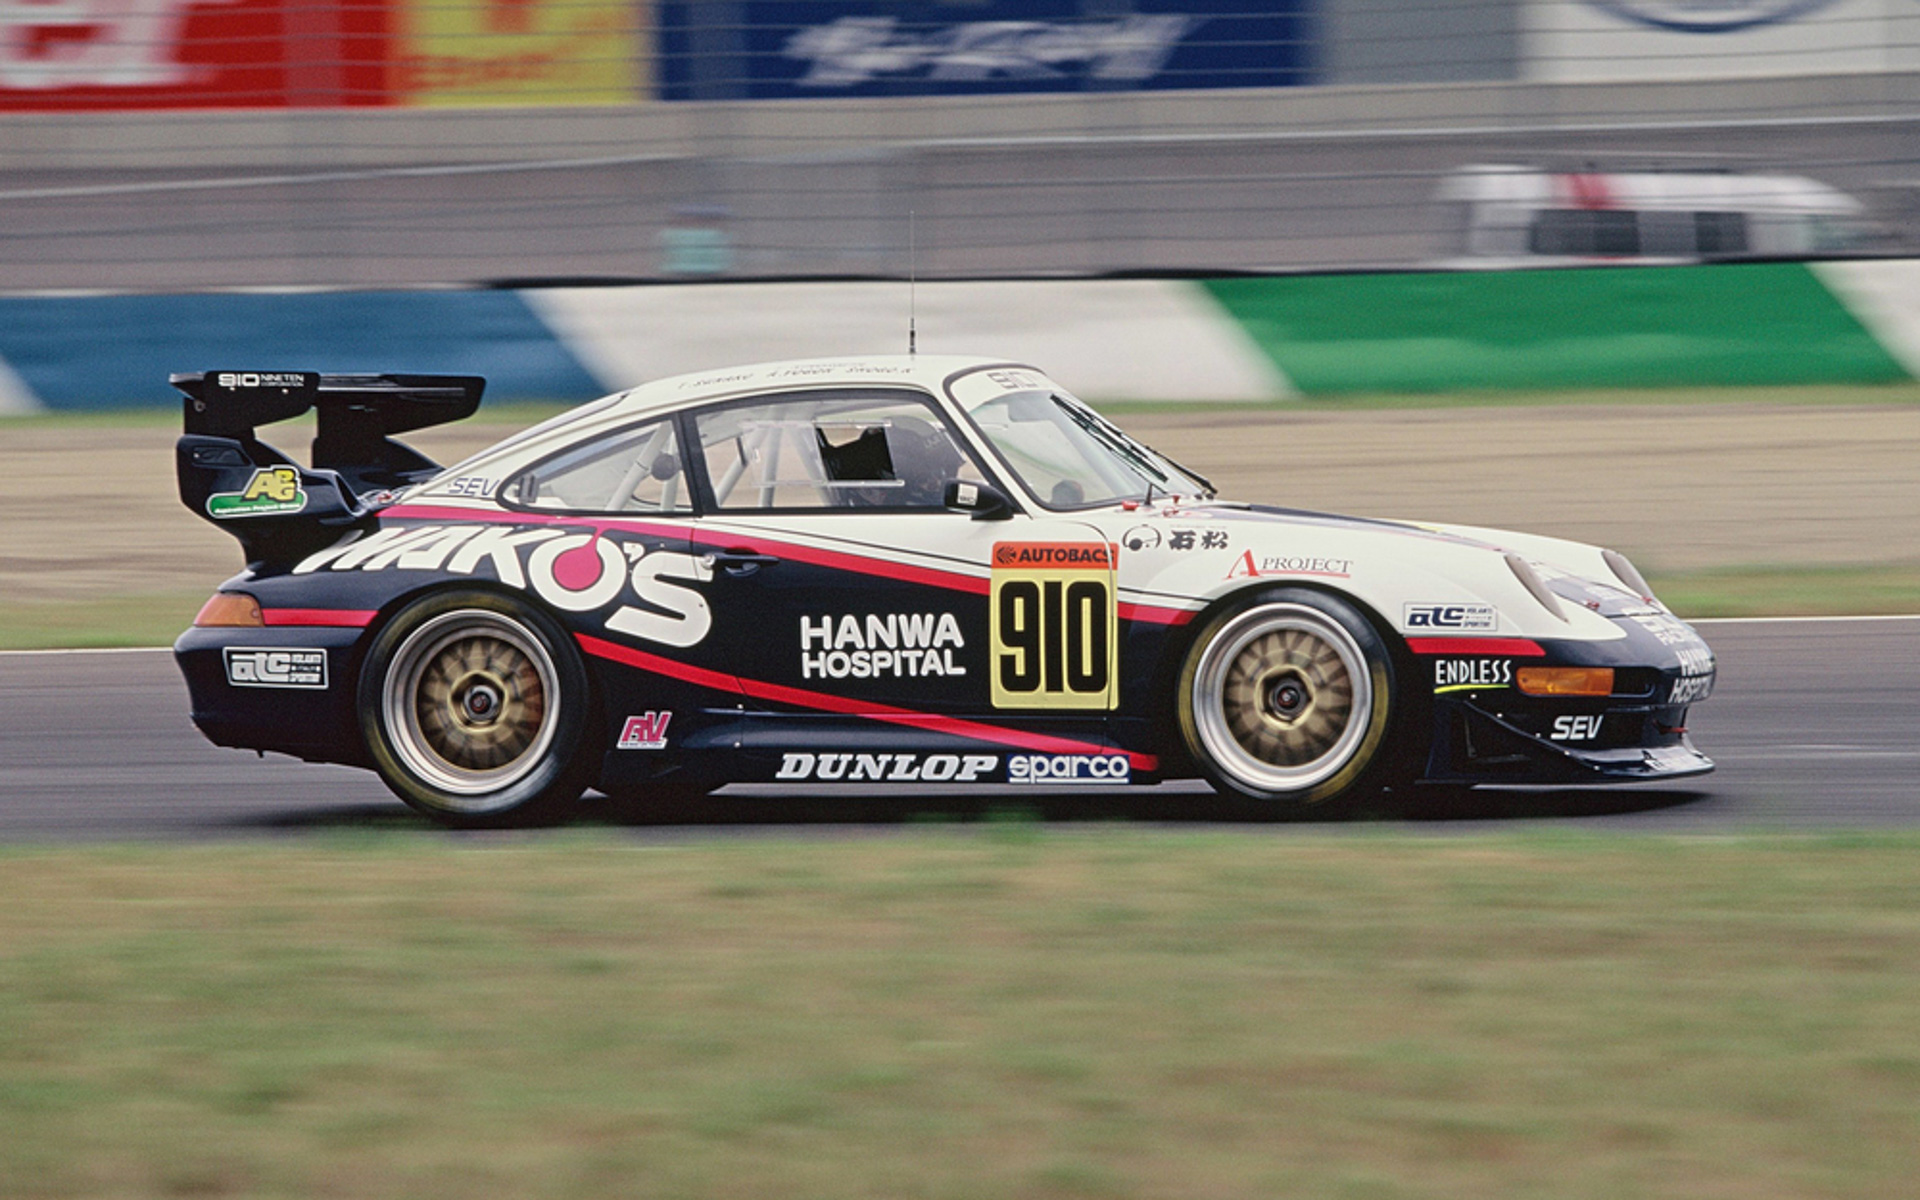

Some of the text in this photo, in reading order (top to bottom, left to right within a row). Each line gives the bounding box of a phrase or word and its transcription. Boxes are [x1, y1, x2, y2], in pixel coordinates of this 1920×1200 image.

[218, 373, 305, 387] 910 NINETEN
[448, 477, 500, 496] SEV
[1018, 548, 1116, 563] AUTOBACS
[1262, 557, 1354, 573] PROJECT
[292, 525, 714, 649] WAKO'S
[800, 613, 965, 651] HANWA
[999, 580, 1109, 693] 910
[802, 648, 967, 679] HOSPITAL
[1435, 659, 1512, 684] ENDLESS
[1550, 714, 1604, 740] SEV
[775, 753, 999, 781] DUNLOP
[1009, 755, 1130, 784] sparco
